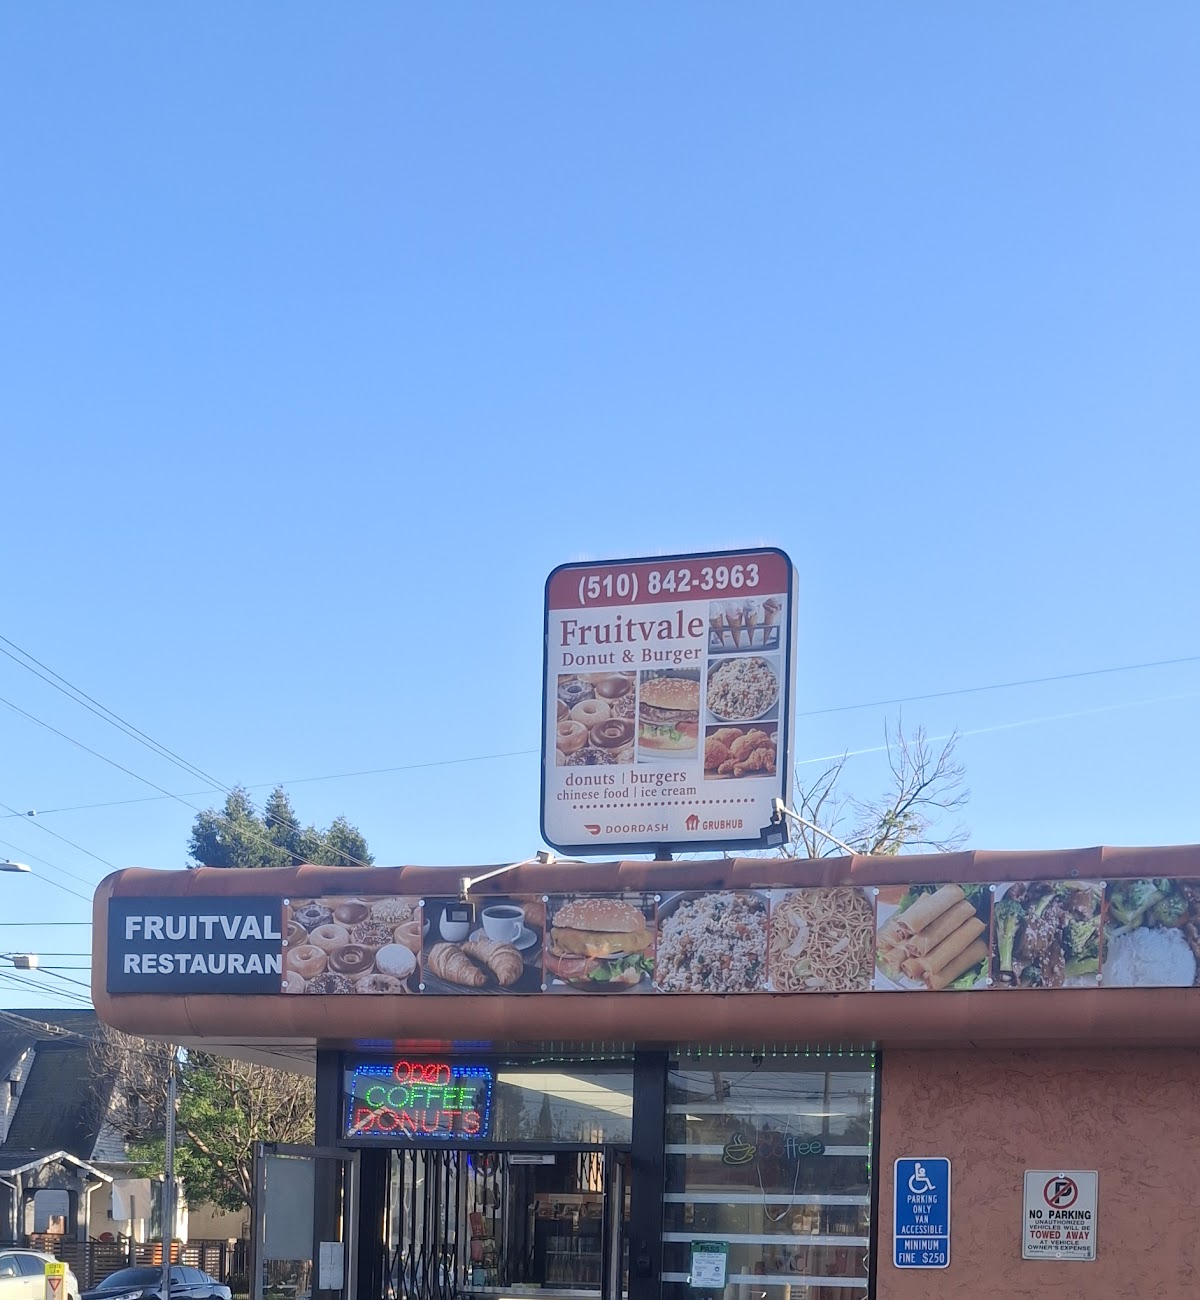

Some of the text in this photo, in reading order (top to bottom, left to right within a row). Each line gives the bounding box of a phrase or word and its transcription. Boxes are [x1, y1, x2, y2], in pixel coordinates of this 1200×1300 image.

[578, 563, 760, 605] (510) 842-3963
[560, 609, 704, 647] Fruitvale
[561, 648, 702, 667] Donut & Burger
[565, 770, 687, 787] donuts burgers
[556, 786, 697, 801] chinese food ice cream
[605, 823, 669, 834] DOORDASH
[702, 819, 743, 831] GRUBHUB
[125, 915, 281, 940] FRUITVAL
[366, 1085, 476, 1110] COFFEE
[354, 1107, 480, 1133] DONUTS
[907, 1194, 938, 1204] PARKING
[913, 1205, 932, 1214] ONLY
[1029, 1210, 1091, 1220] NO PARKING
[915, 1215, 929, 1223] VAN
[901, 1225, 943, 1234] ACCESSIBLE
[1030, 1230, 1090, 1240] TOWED AWAY
[700, 1245, 720, 1253] PASS
[904, 1240, 939, 1251] MINIMUM
[898, 1252, 945, 1264] FINE $250
